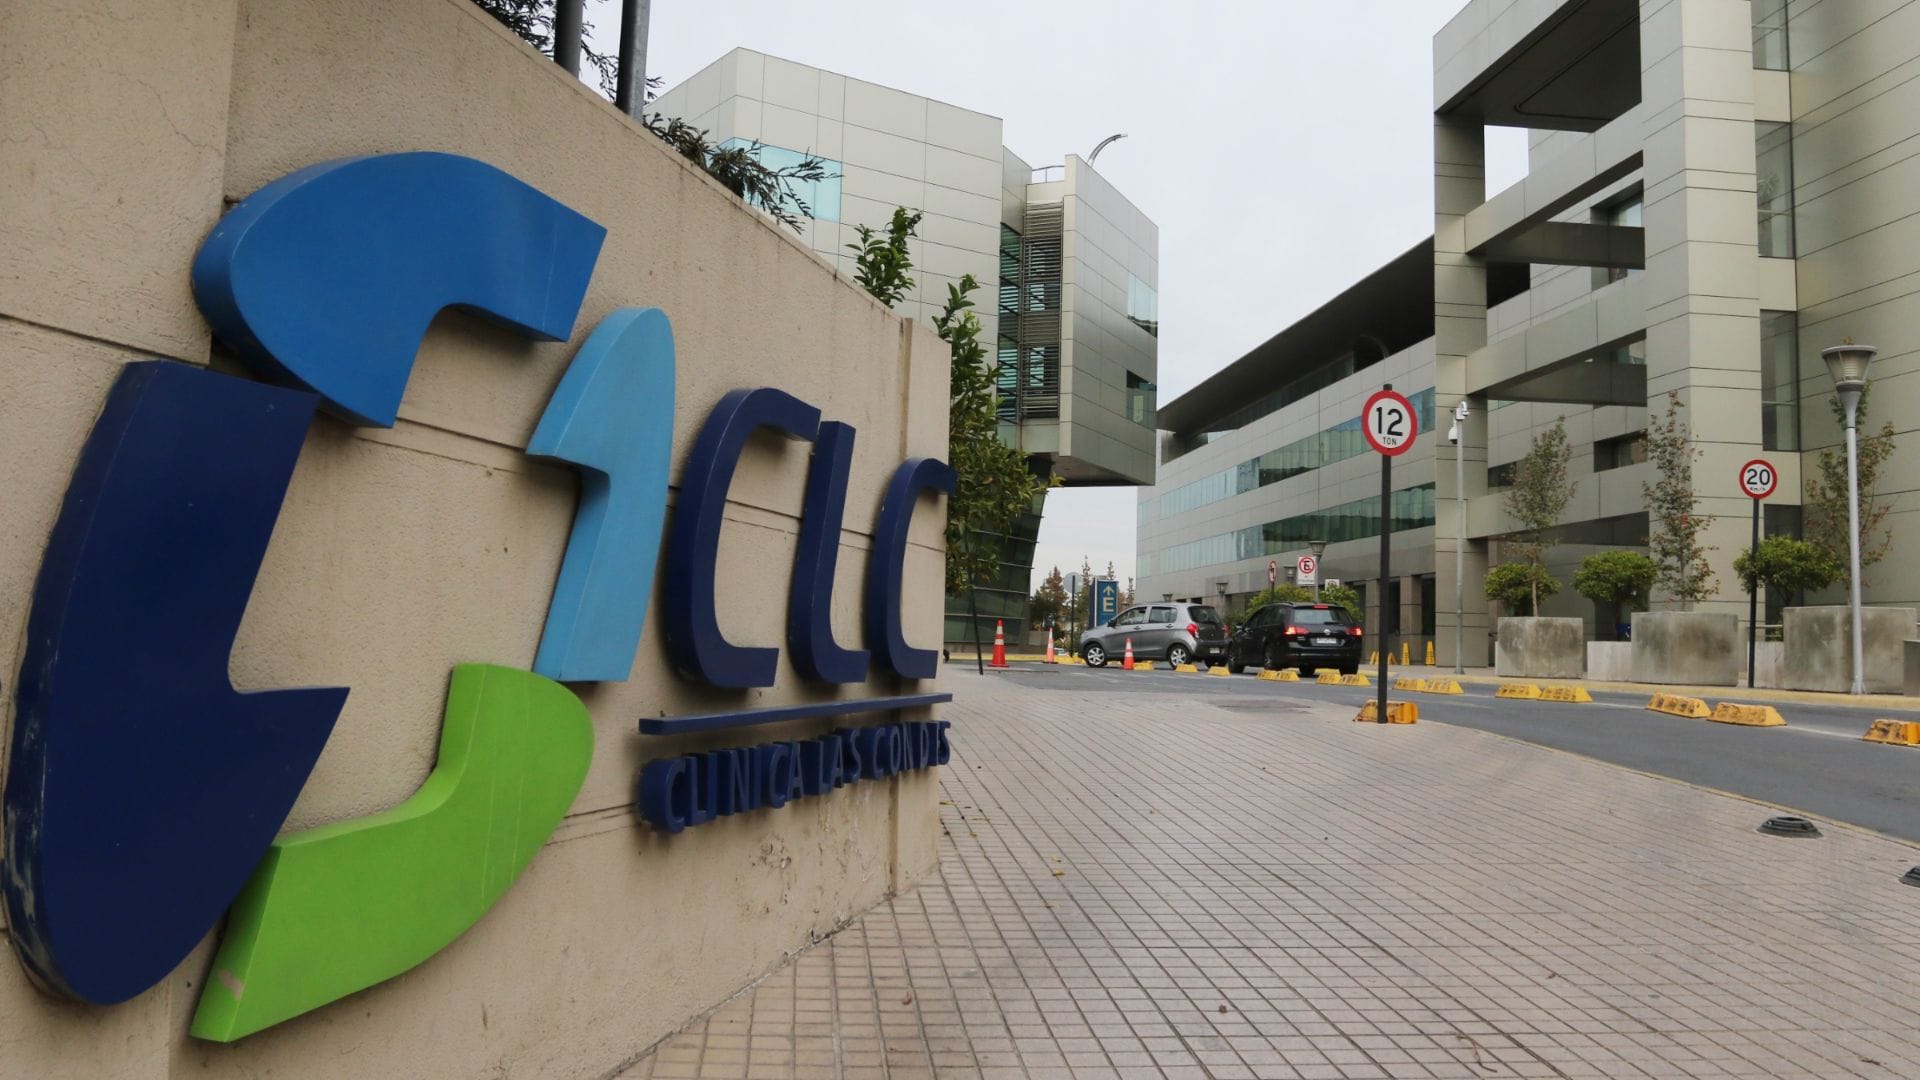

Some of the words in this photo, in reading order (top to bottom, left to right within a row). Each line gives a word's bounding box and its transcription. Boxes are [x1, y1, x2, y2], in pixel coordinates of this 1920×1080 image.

[1376, 406, 1403, 436] 12
[1383, 436, 1397, 445] TON
[1747, 468, 1770, 485] 20
[667, 388, 958, 687] CLC
[1103, 597, 1114, 612] E
[640, 741, 801, 834] CLINICA
[801, 727, 862, 795] LAS
